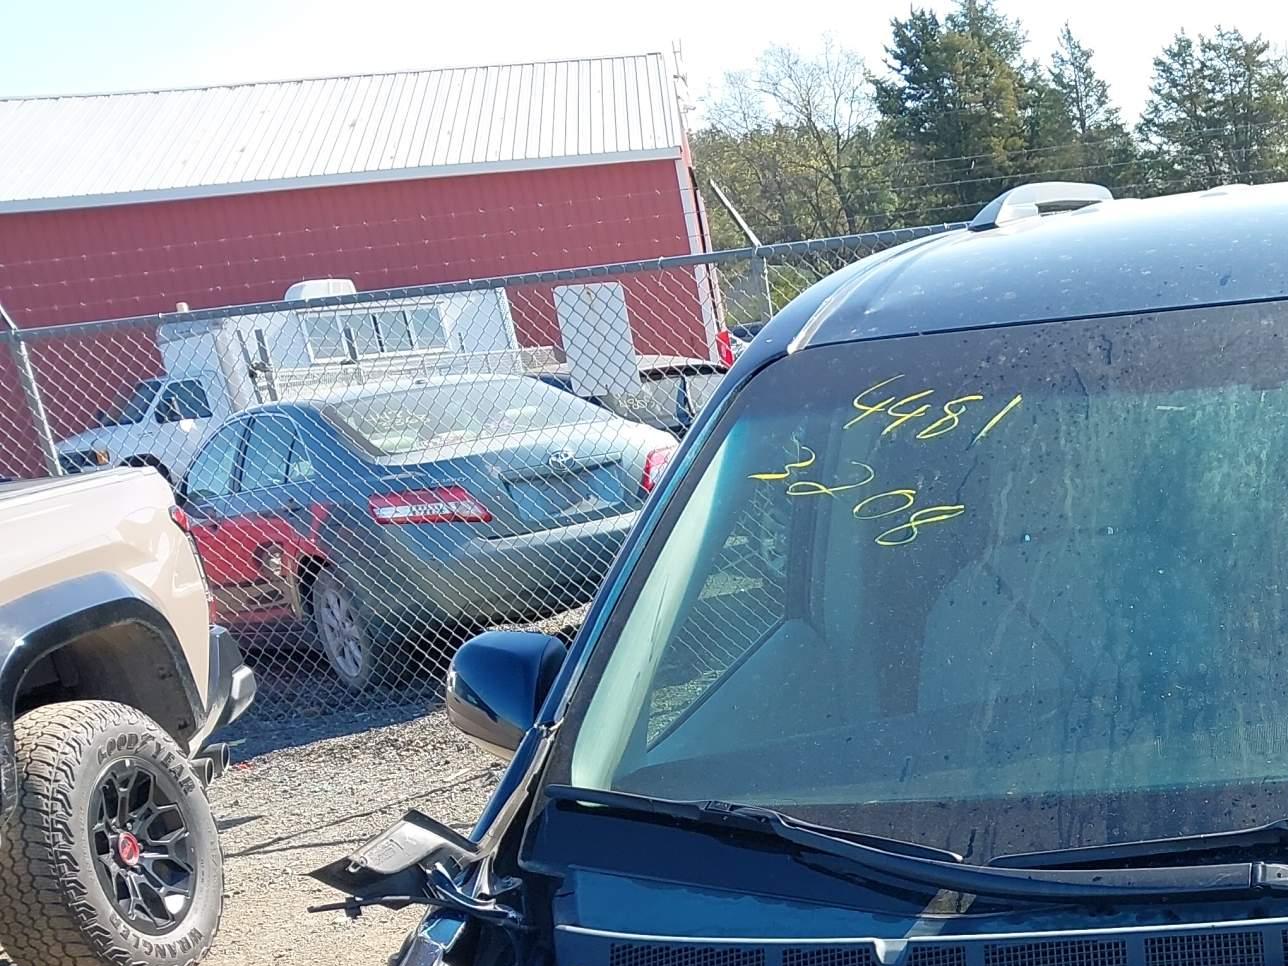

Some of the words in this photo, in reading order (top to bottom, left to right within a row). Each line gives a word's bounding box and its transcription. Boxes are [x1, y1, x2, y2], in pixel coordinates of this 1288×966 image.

[843, 374, 1023, 444] 4481
[747, 446, 965, 546] 3208
[108, 910, 204, 960] WRANGLER
